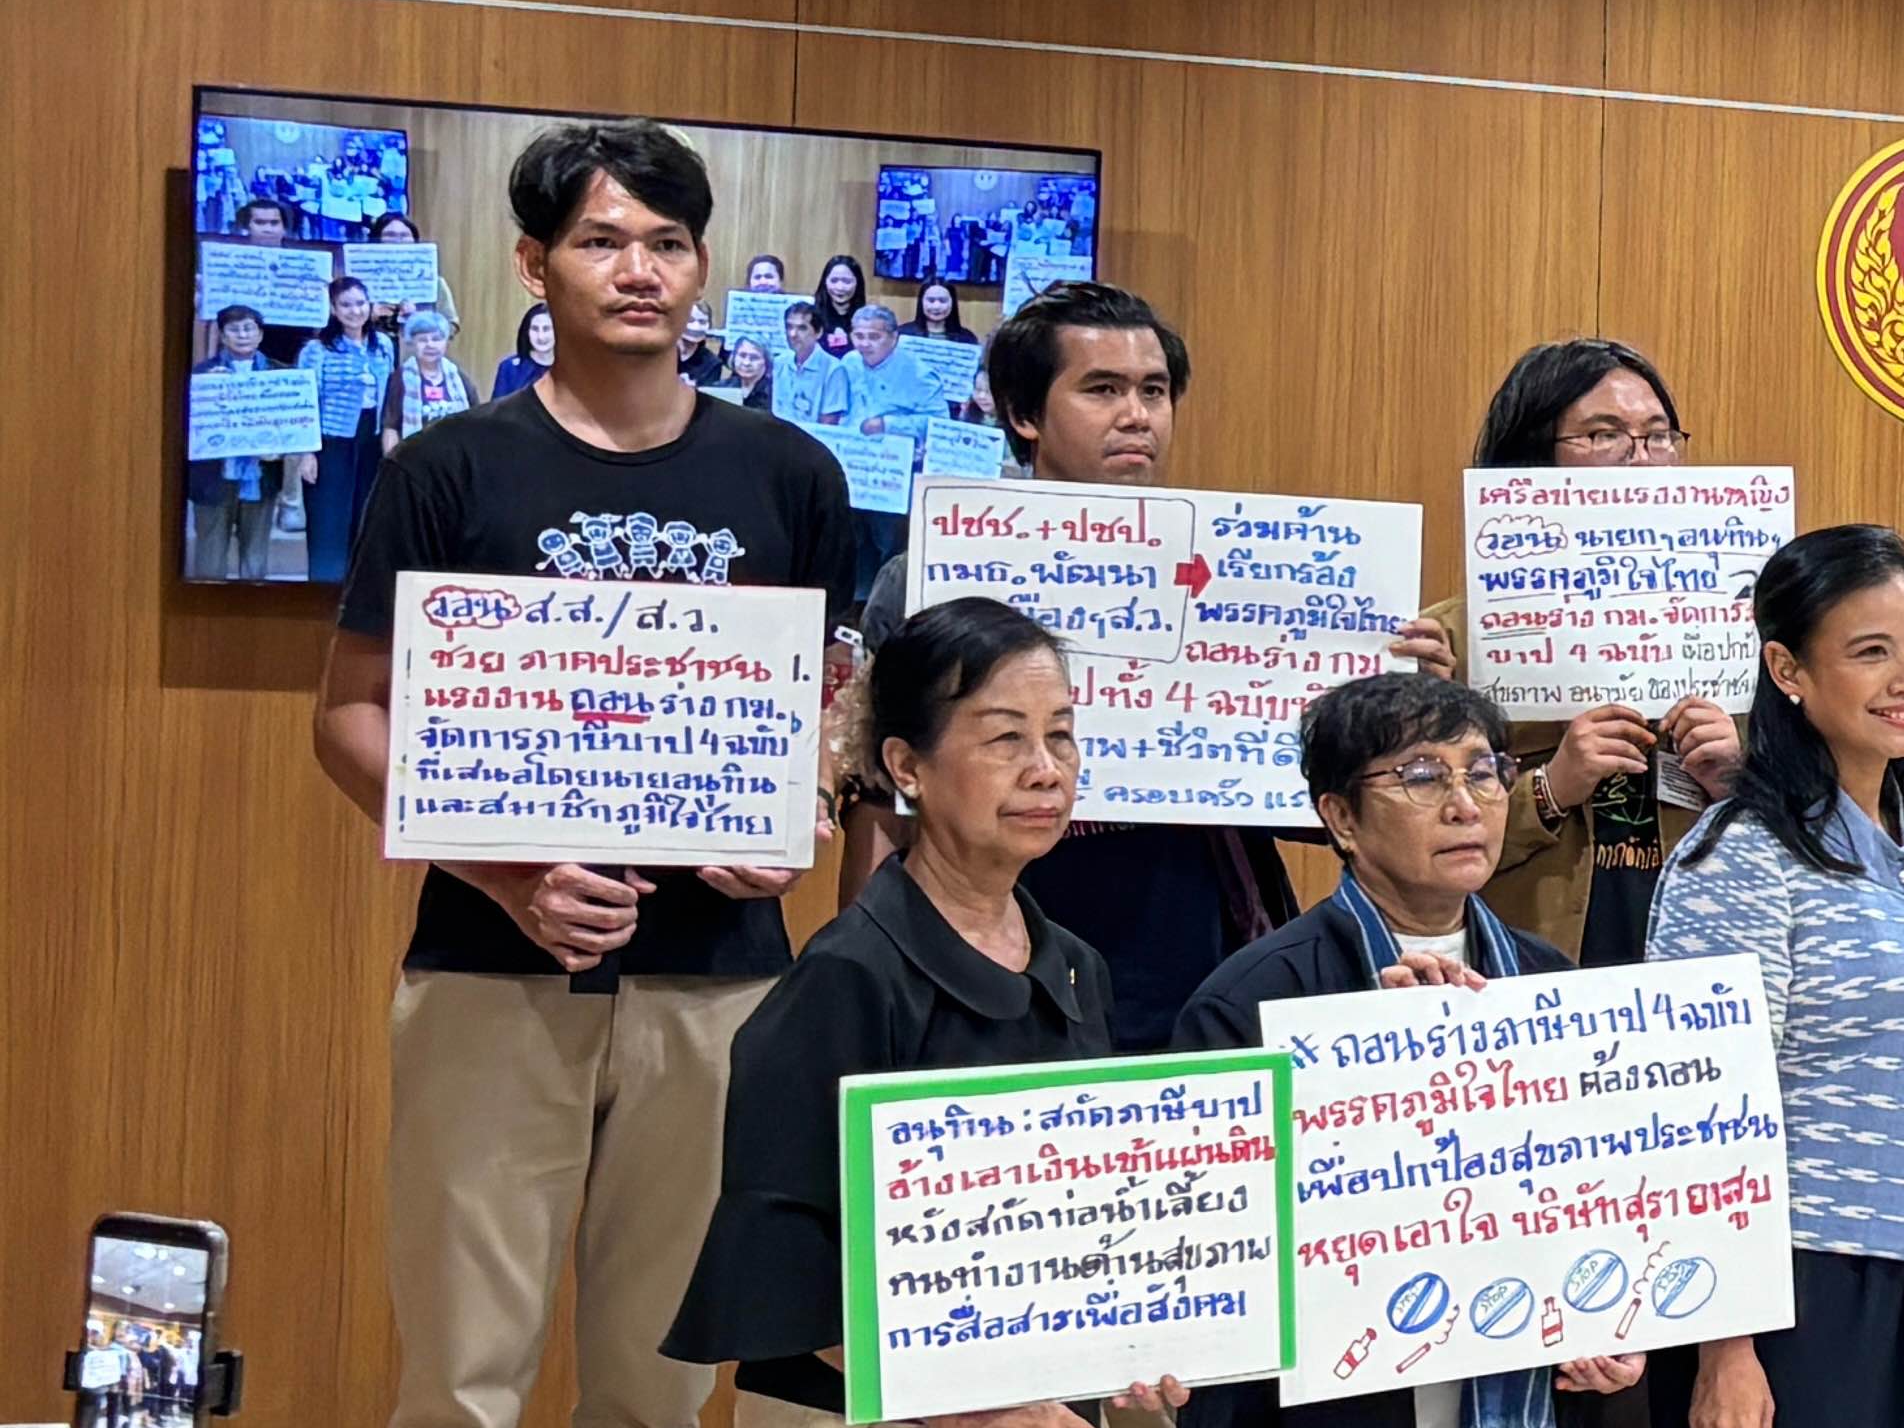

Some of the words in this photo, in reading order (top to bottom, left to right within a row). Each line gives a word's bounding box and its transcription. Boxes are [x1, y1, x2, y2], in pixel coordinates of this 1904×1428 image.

[1479, 475, 1789, 511] เครือข่ายแรงงานหญิง
[1212, 502, 1361, 545] ร่วมค้าน
[1488, 532, 1562, 550] วอน
[1216, 548, 1356, 588] เรียกร้อง
[1479, 556, 1719, 600] พรรคภูมิใจไทย
[519, 646, 772, 681] ภาคประชาชน
[1598, 634, 1672, 662] ฉบับ
[416, 718, 693, 756] จัดการภาษีบาป
[723, 722, 789, 758] ฉบับ
[416, 789, 773, 836] และสมาชิกภูมิใจไทย
[1680, 982, 1752, 1032] ฉบับ
[1293, 1060, 1568, 1138] พรรคภูมิใจไทย
[1580, 1041, 1721, 1099] ต้องถอน
[1298, 1094, 1778, 1205] เพื่อปกป้องสุขภาพประชาชน
[1299, 1186, 1499, 1286] หยุดเอาใจ
